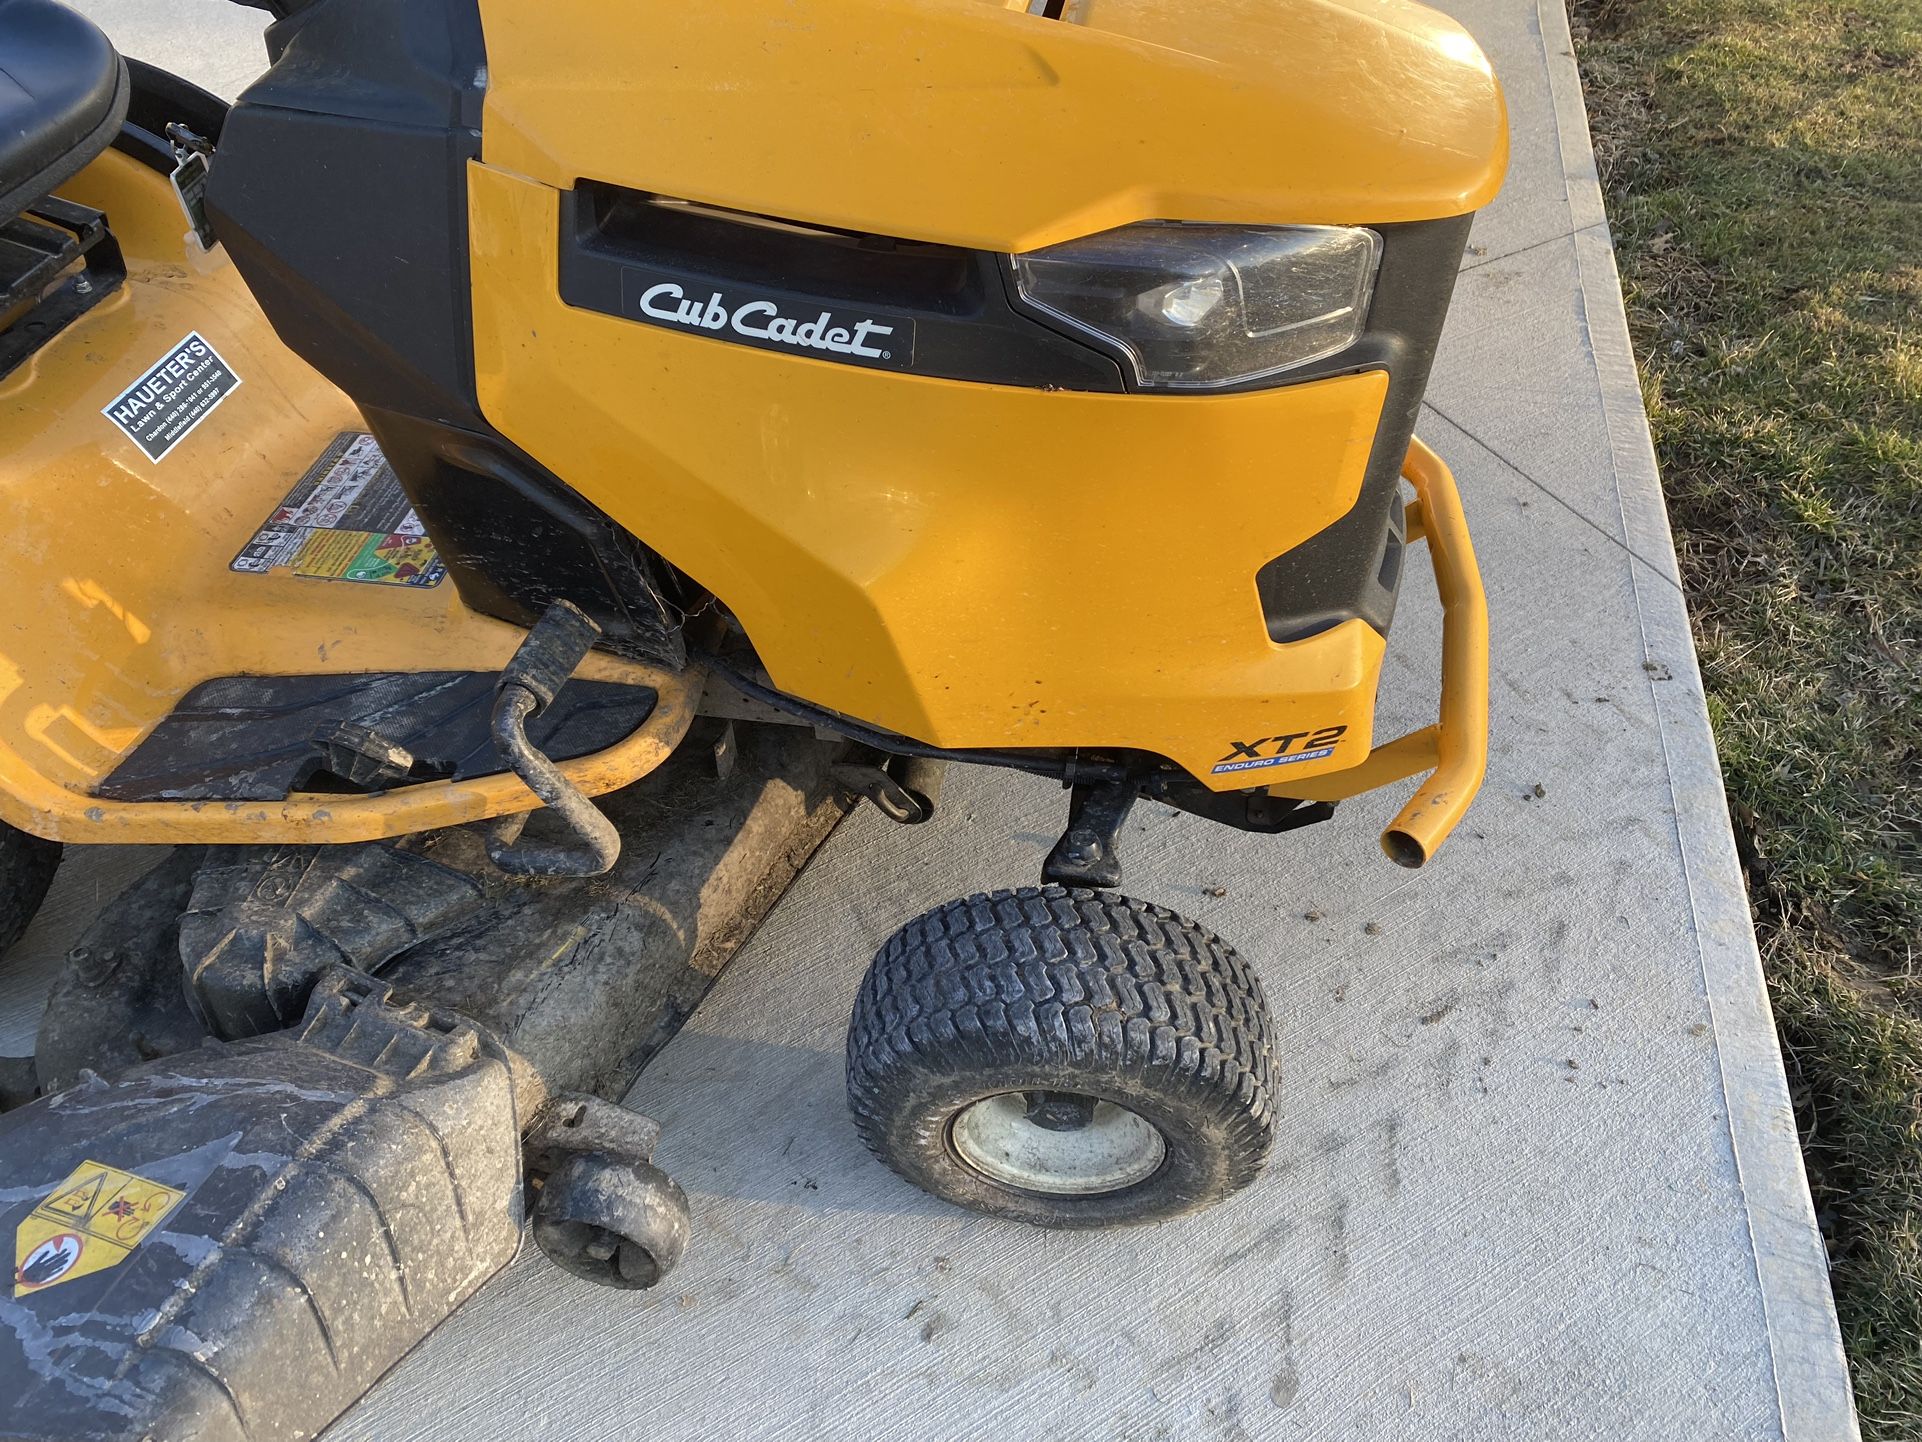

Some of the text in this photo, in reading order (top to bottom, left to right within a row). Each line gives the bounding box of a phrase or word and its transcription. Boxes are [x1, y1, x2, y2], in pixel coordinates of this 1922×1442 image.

[639, 283, 728, 330] Cub
[113, 341, 206, 424] HAUETER'S
[130, 355, 214, 433] Lawn & Sport Center
[145, 421, 168, 442] Chardon
[197, 387, 204, 396] or
[164, 415, 191, 442] Middlefield
[1214, 749, 1329, 772] ENDURO SERIES
[1217, 725, 1348, 762] XT2
